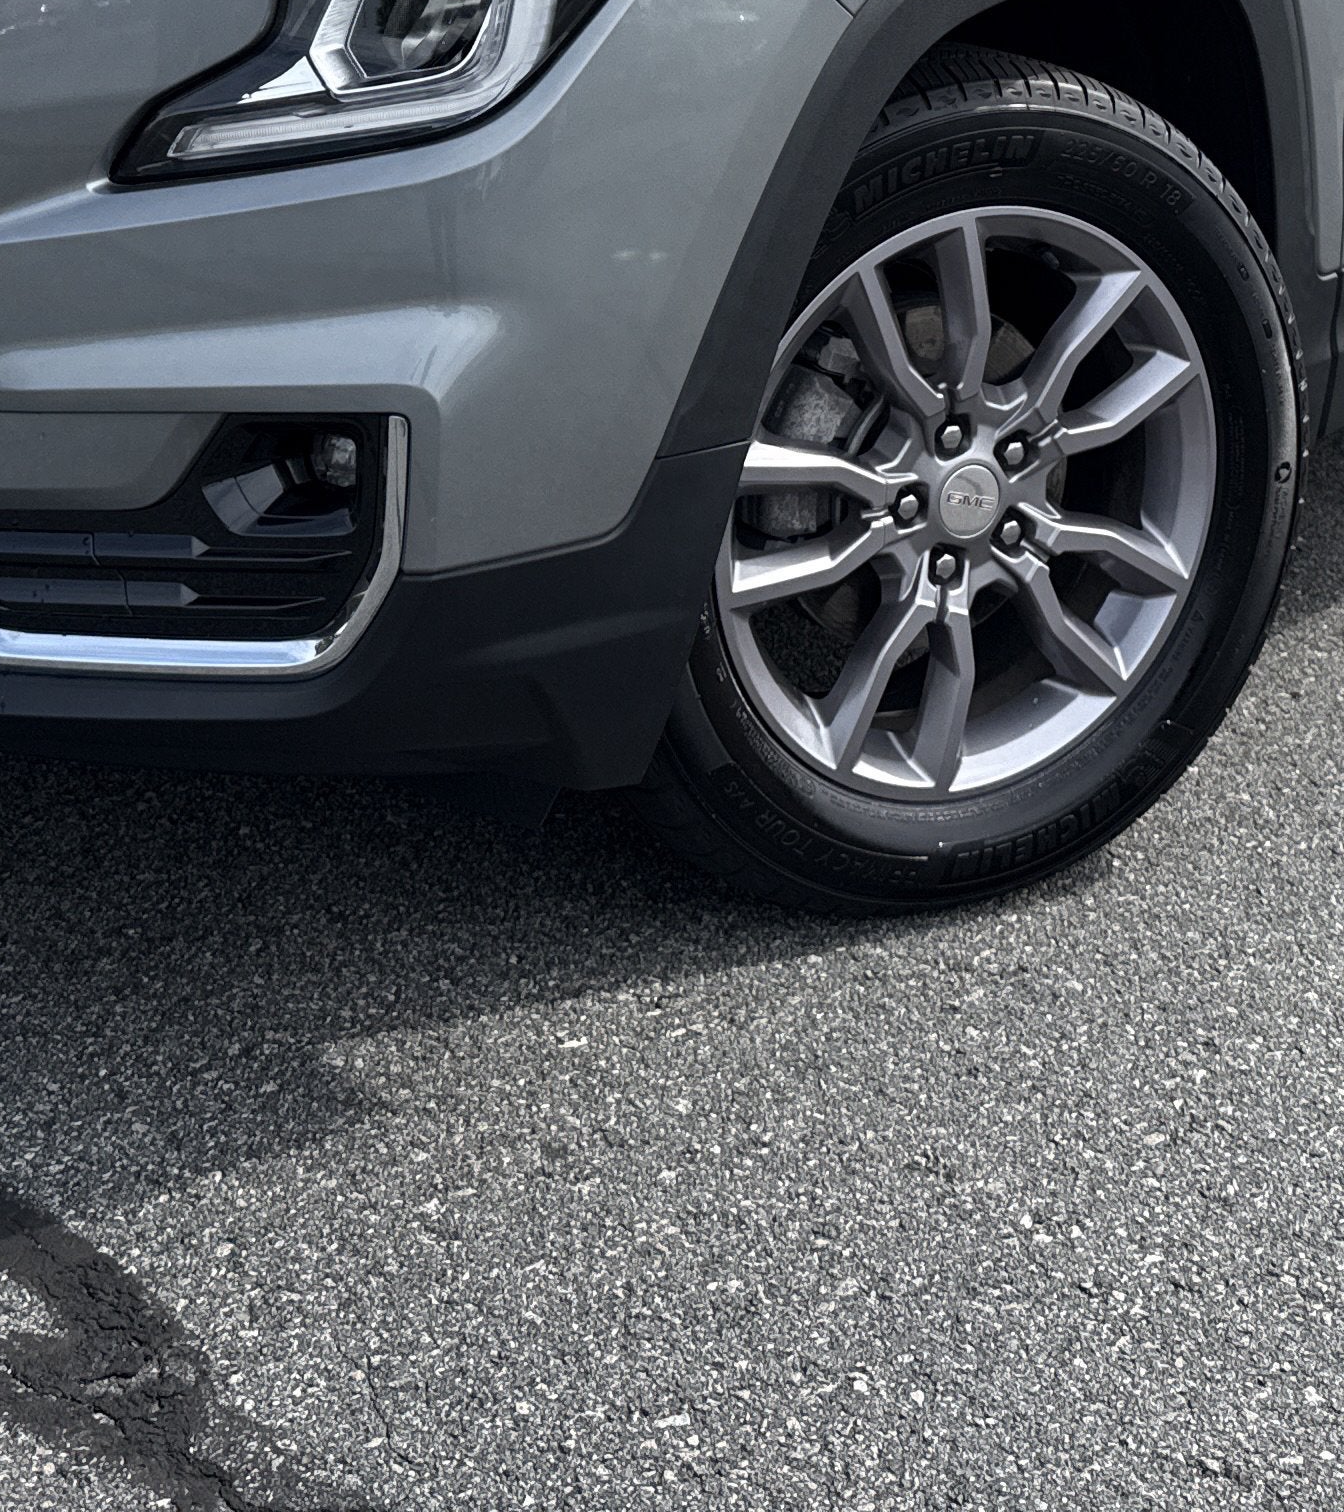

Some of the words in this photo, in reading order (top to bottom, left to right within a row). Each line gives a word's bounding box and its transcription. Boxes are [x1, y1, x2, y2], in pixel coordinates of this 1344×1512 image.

[853, 134, 1036, 212] MICHELIN
[1059, 138, 1138, 179] 225/60
[947, 490, 996, 510] GMC
[755, 808, 813, 857] TOUR
[951, 782, 1121, 881] MICHELIN
